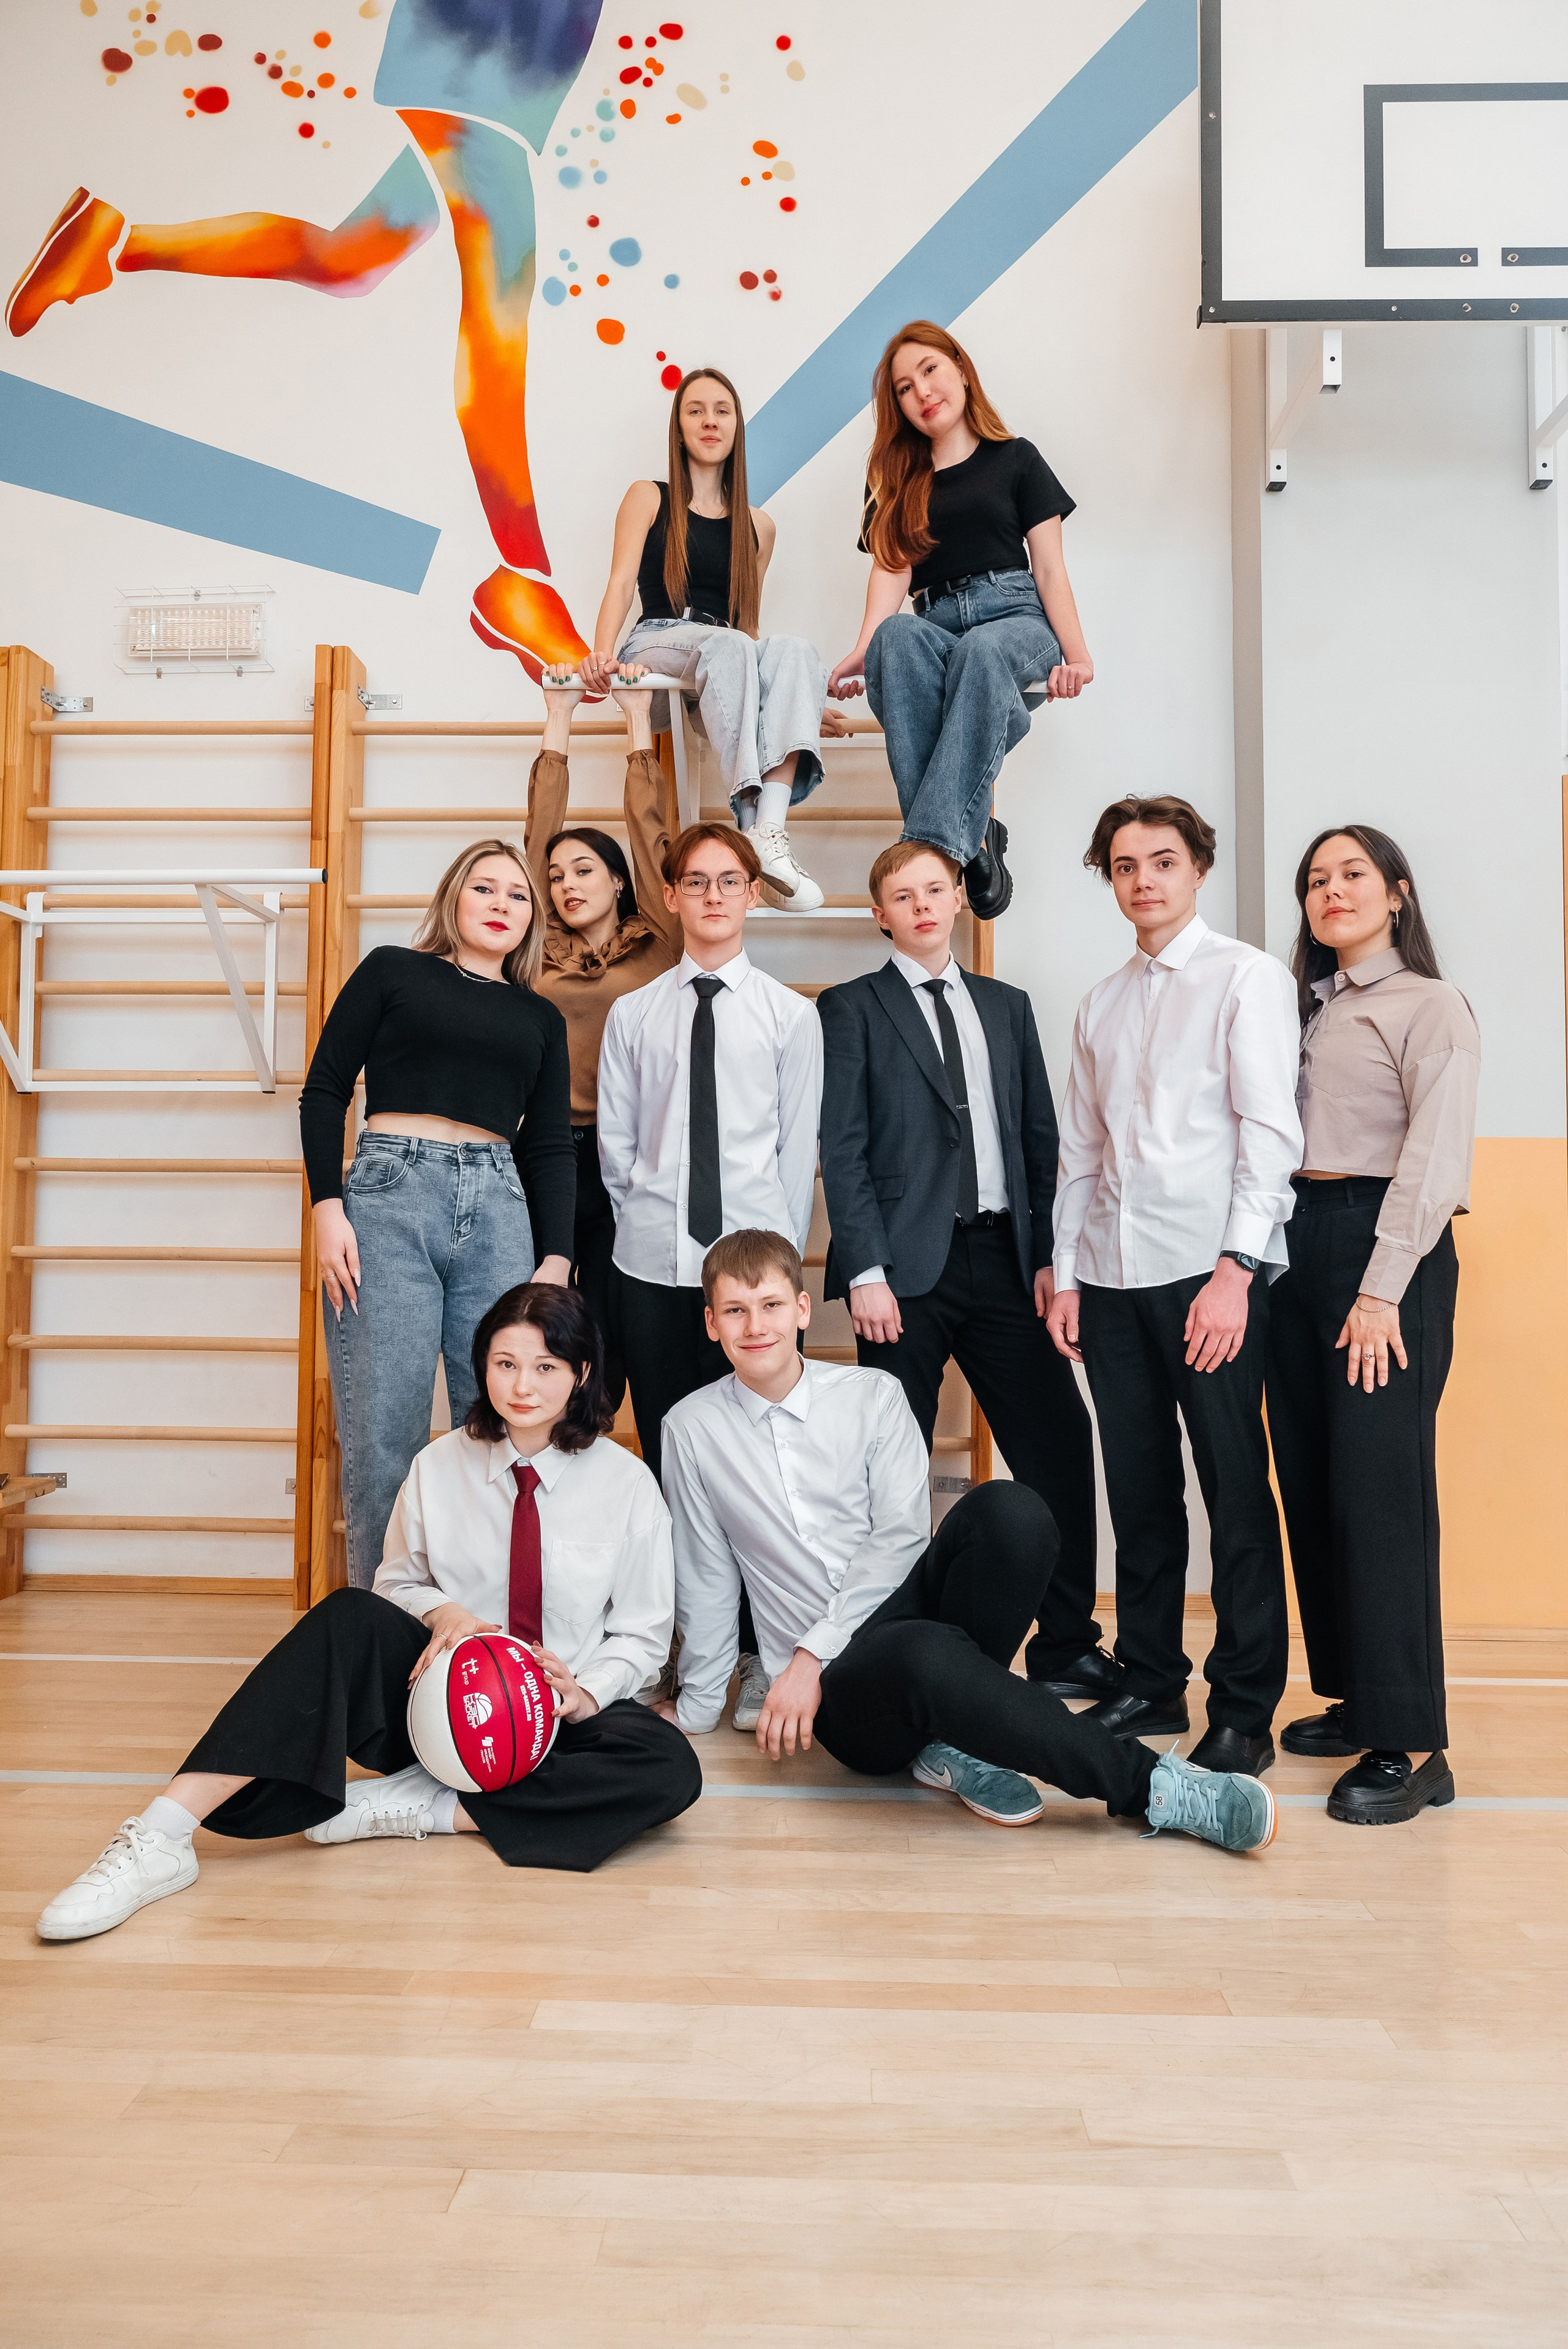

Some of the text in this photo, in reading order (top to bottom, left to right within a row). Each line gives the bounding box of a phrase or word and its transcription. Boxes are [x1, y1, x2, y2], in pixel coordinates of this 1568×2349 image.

[506, 1646, 524, 1662] МЫ
[524, 1671, 541, 1703] ОДНА
[463, 1695, 474, 1726] БАСКЕТ
[529, 1703, 544, 1761] КОМАНДА!
[1156, 1796, 1163, 1806] 58
